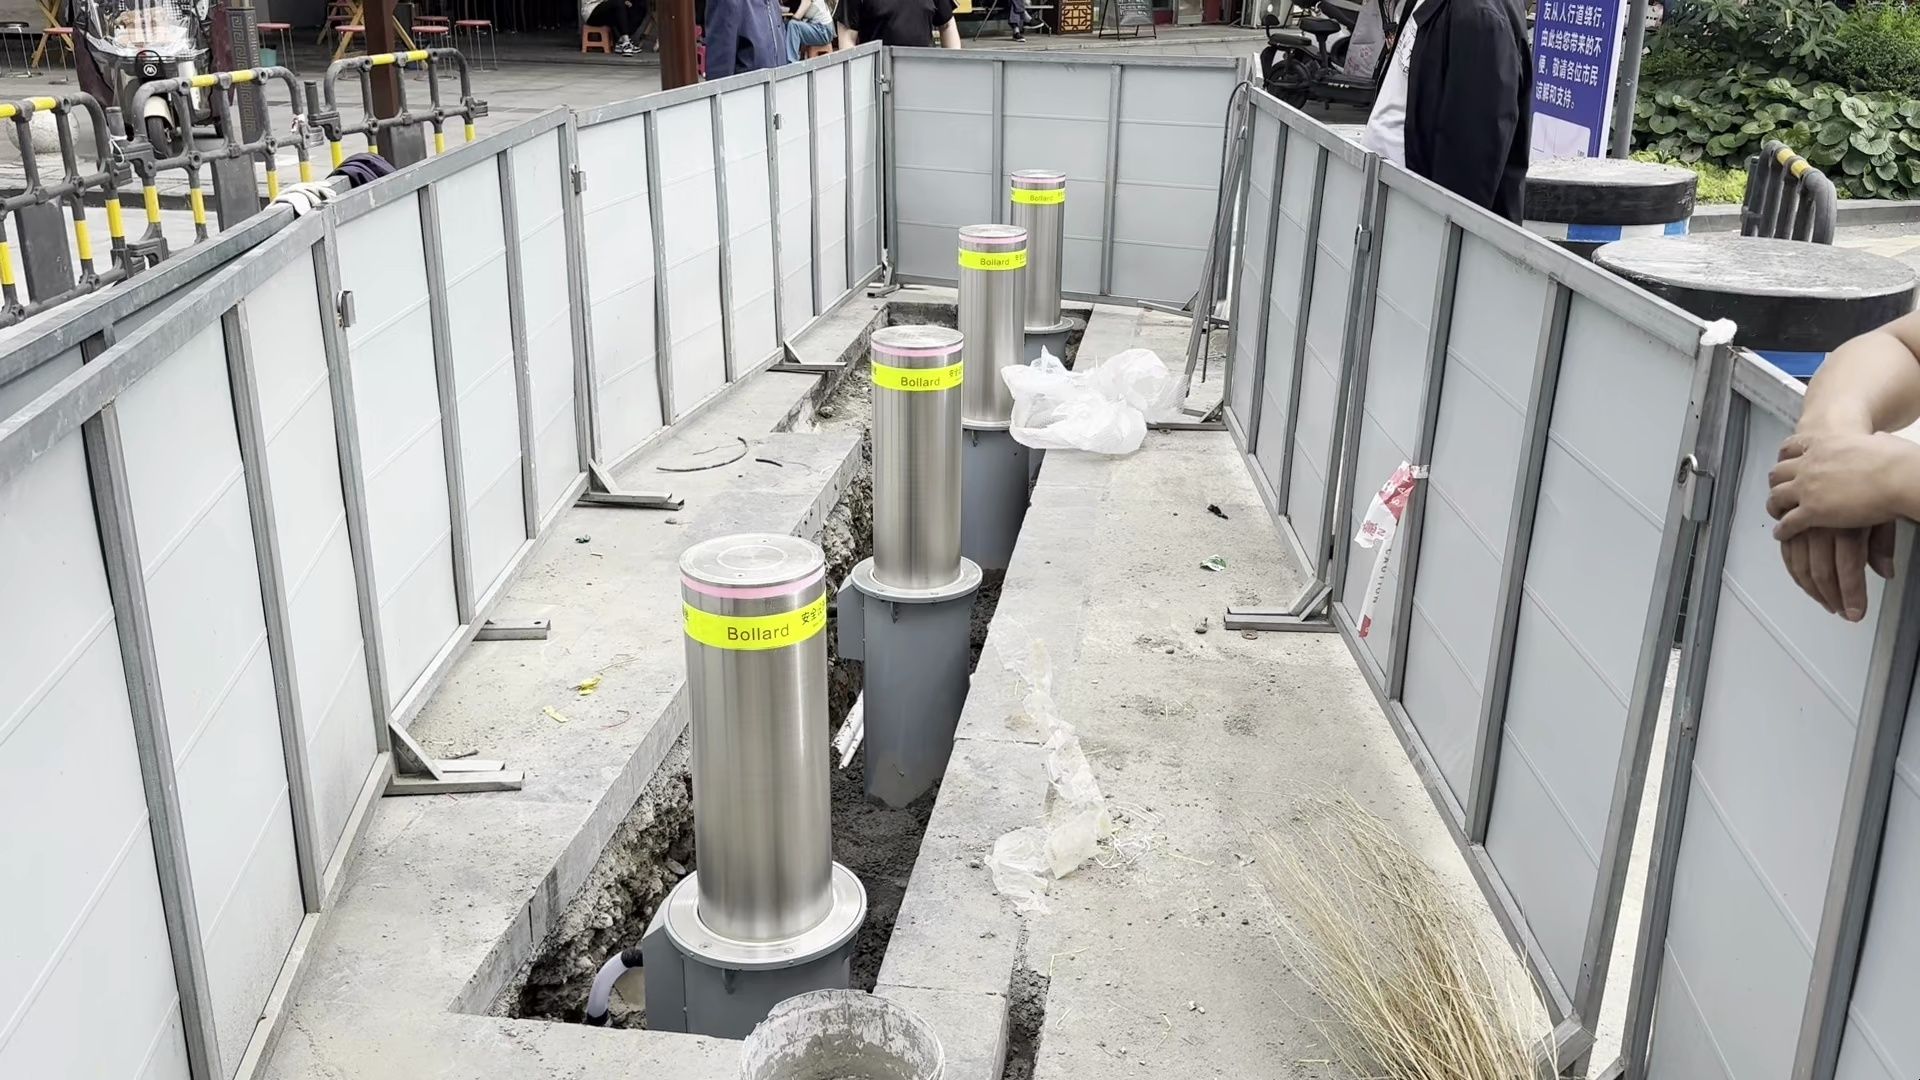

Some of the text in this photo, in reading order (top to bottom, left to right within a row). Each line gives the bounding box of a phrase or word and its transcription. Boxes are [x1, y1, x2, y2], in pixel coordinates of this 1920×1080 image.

[1543, 1, 1605, 29] 友从人行道绕行，
[1540, 28, 1603, 58] 由此给您带来的不
[1537, 54, 1599, 87] 便，敬请各位市民
[1535, 80, 1575, 109] 谅解和支持。
[1029, 194, 1054, 202] Bollard
[980, 258, 1010, 266] Bollard
[900, 376, 941, 387] Bollard
[727, 624, 789, 641] Bollard
